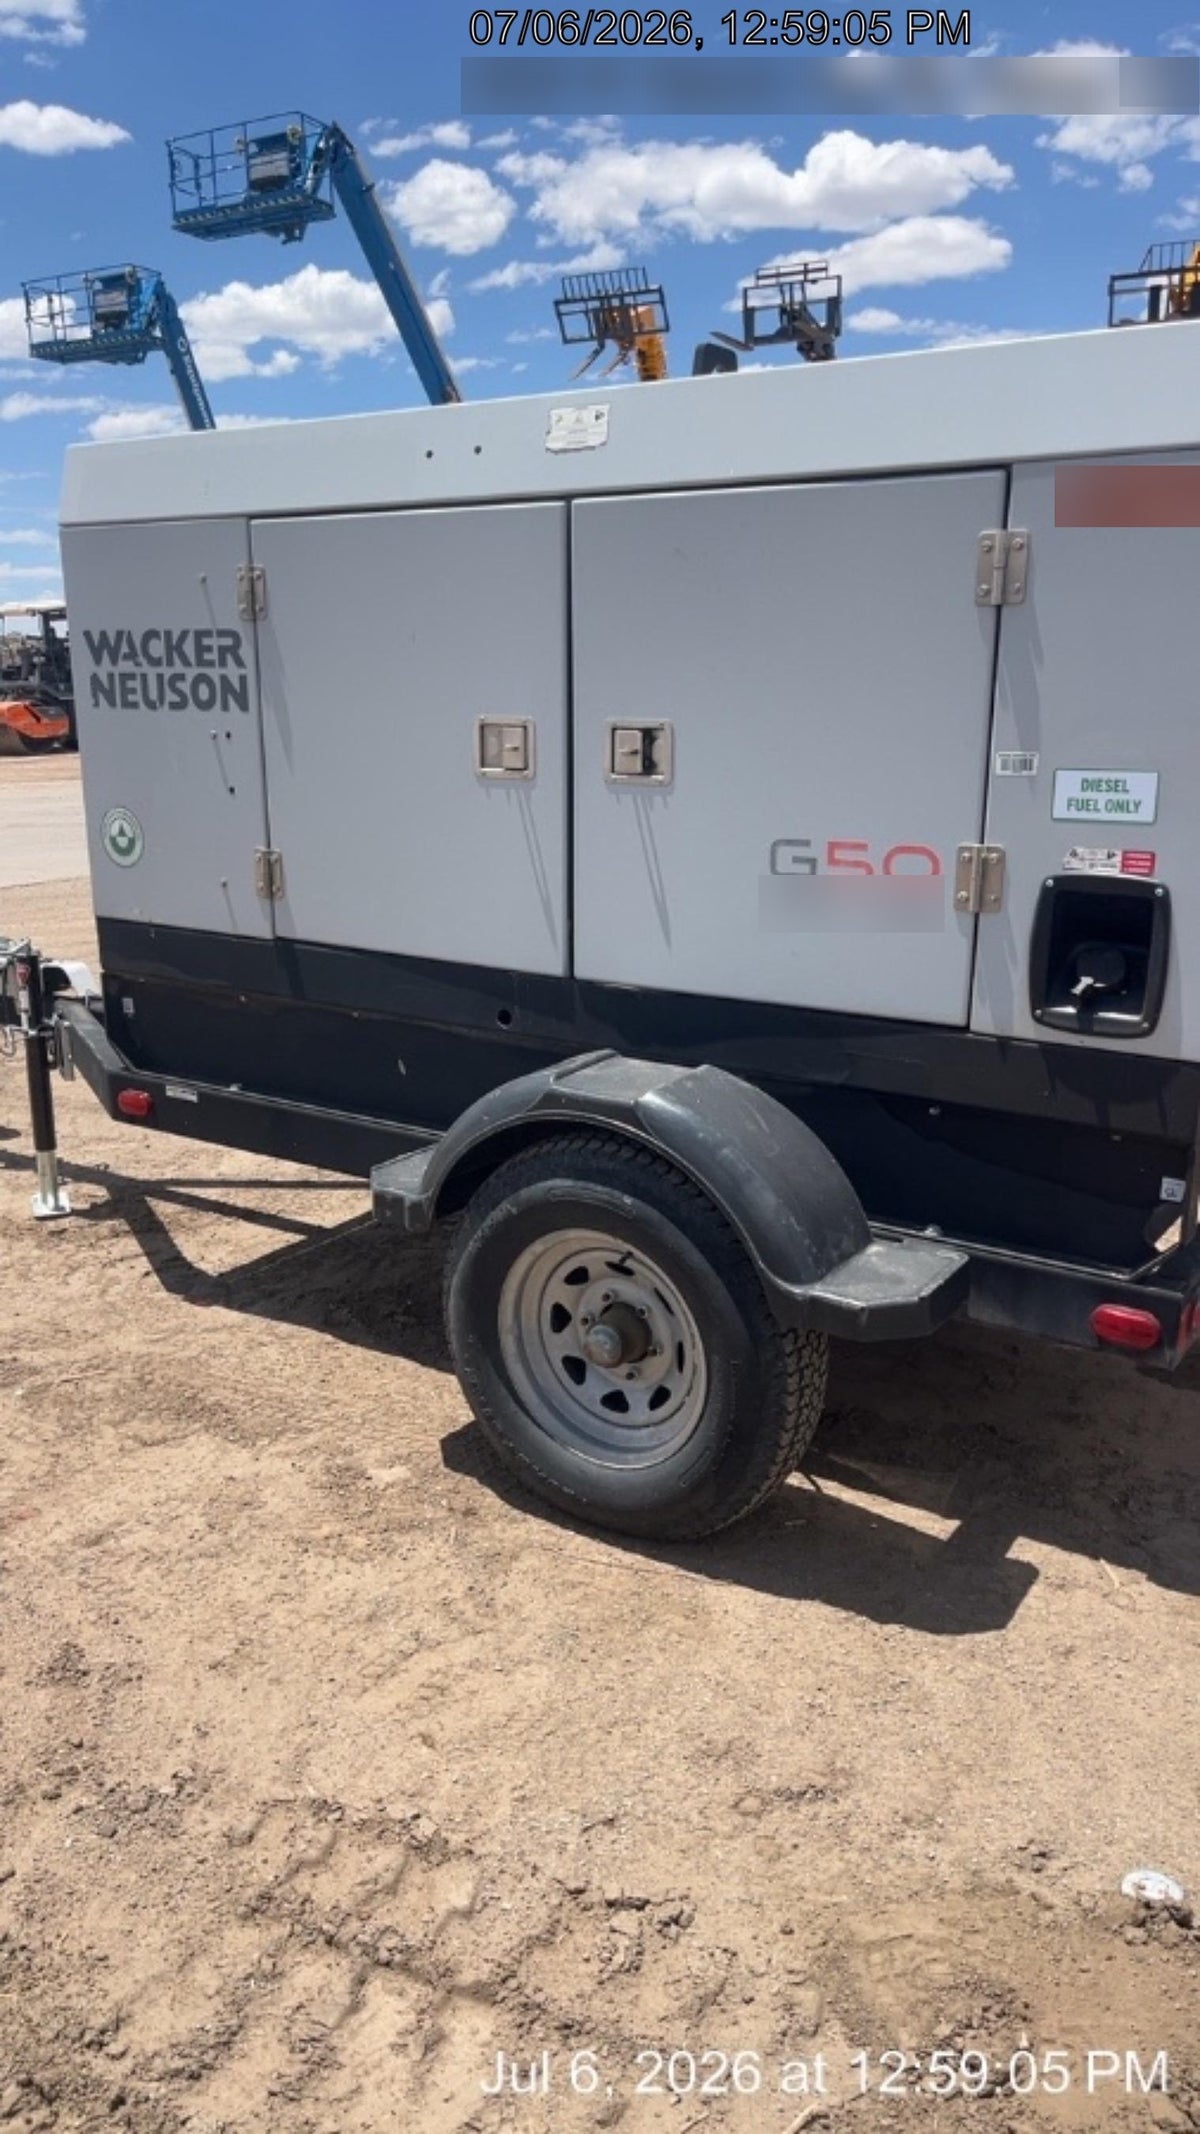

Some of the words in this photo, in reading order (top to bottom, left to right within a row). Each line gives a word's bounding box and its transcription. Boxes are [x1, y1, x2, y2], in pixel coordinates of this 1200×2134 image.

[82, 628, 247, 669] WACKER
[89, 672, 249, 712] NEUSON
[1080, 777, 1130, 793] DIESEL
[1066, 797, 1101, 812] FUEL
[1105, 799, 1142, 814] ONLY
